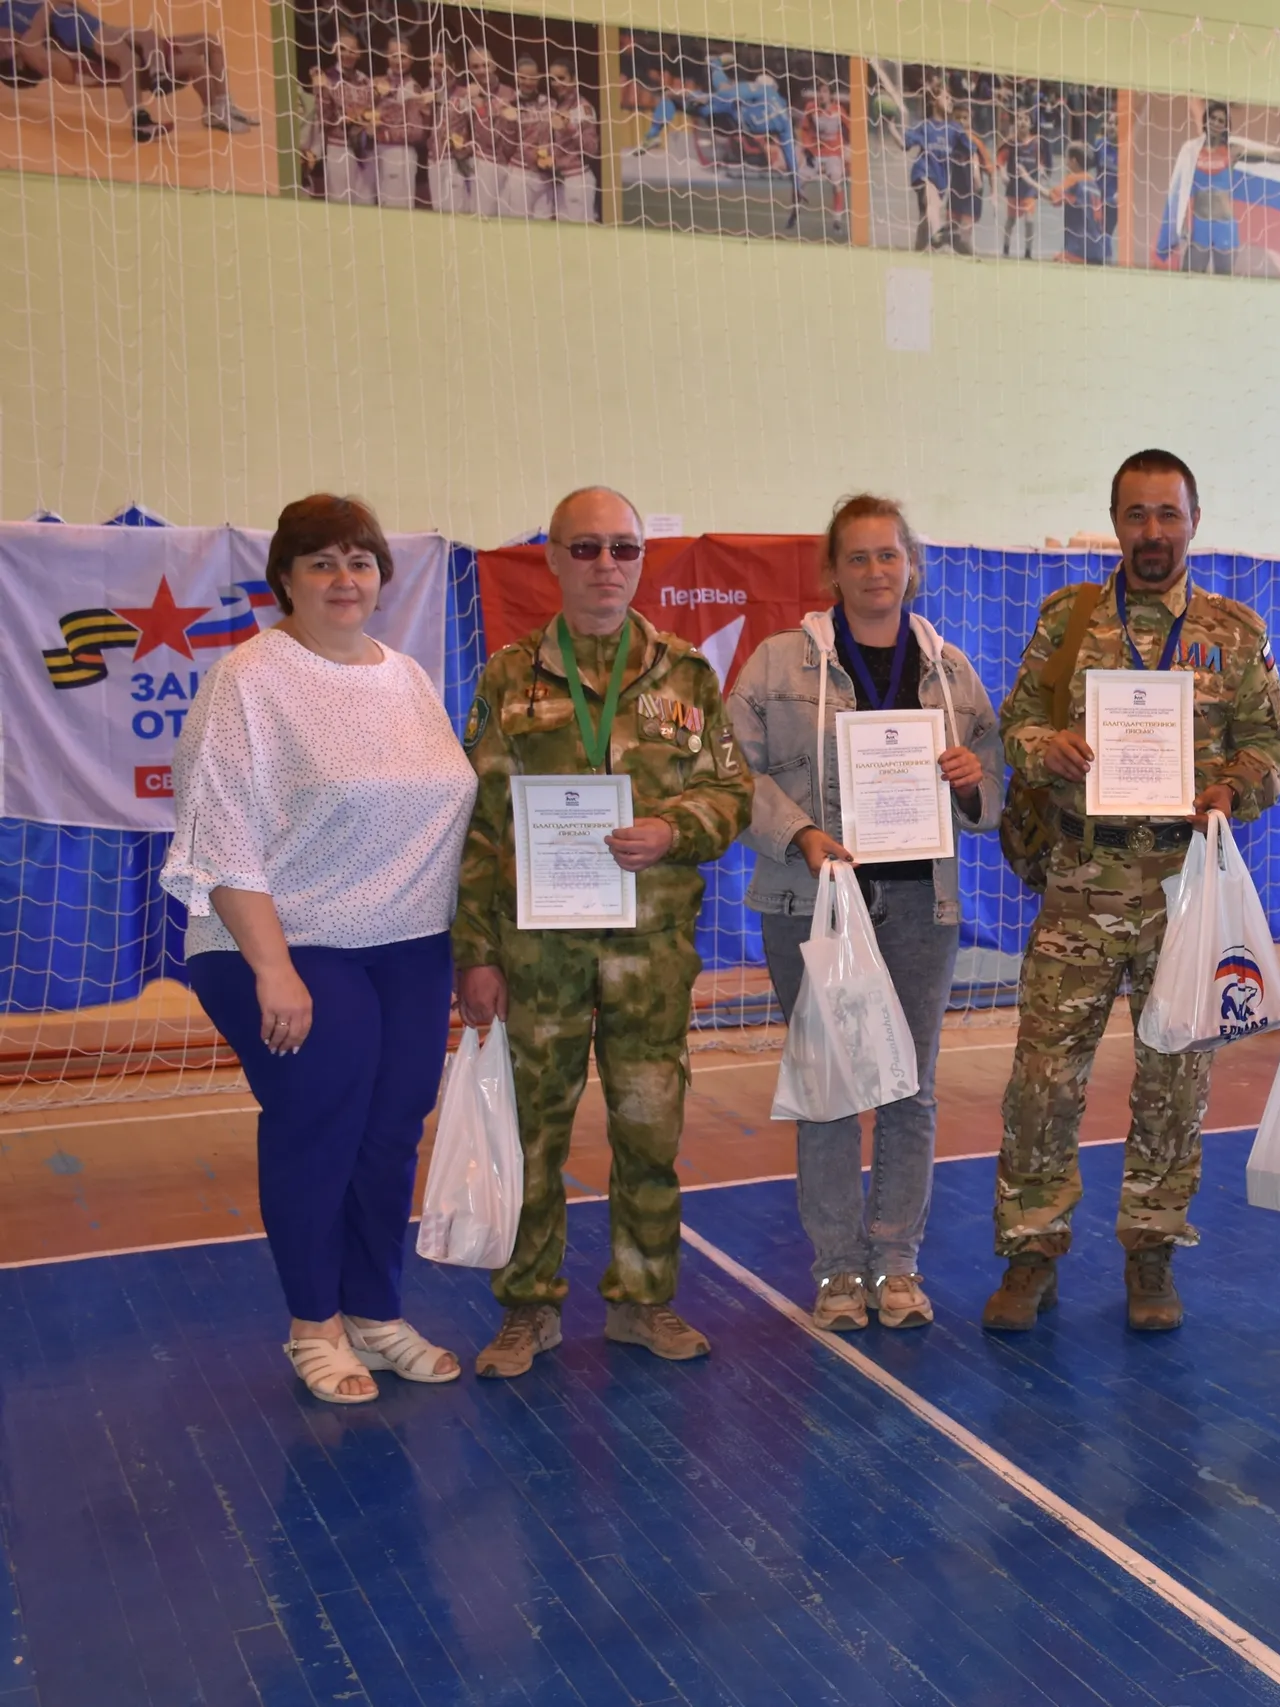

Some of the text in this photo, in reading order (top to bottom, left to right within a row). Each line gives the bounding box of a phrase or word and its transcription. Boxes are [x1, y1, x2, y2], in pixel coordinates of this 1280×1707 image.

[660, 586, 748, 610] Первые
[855, 760, 931, 769] БЛАГОДАРСТВЕННОЕ
[532, 822, 614, 830] БЛАГОДАРСТВЕННОЕ
